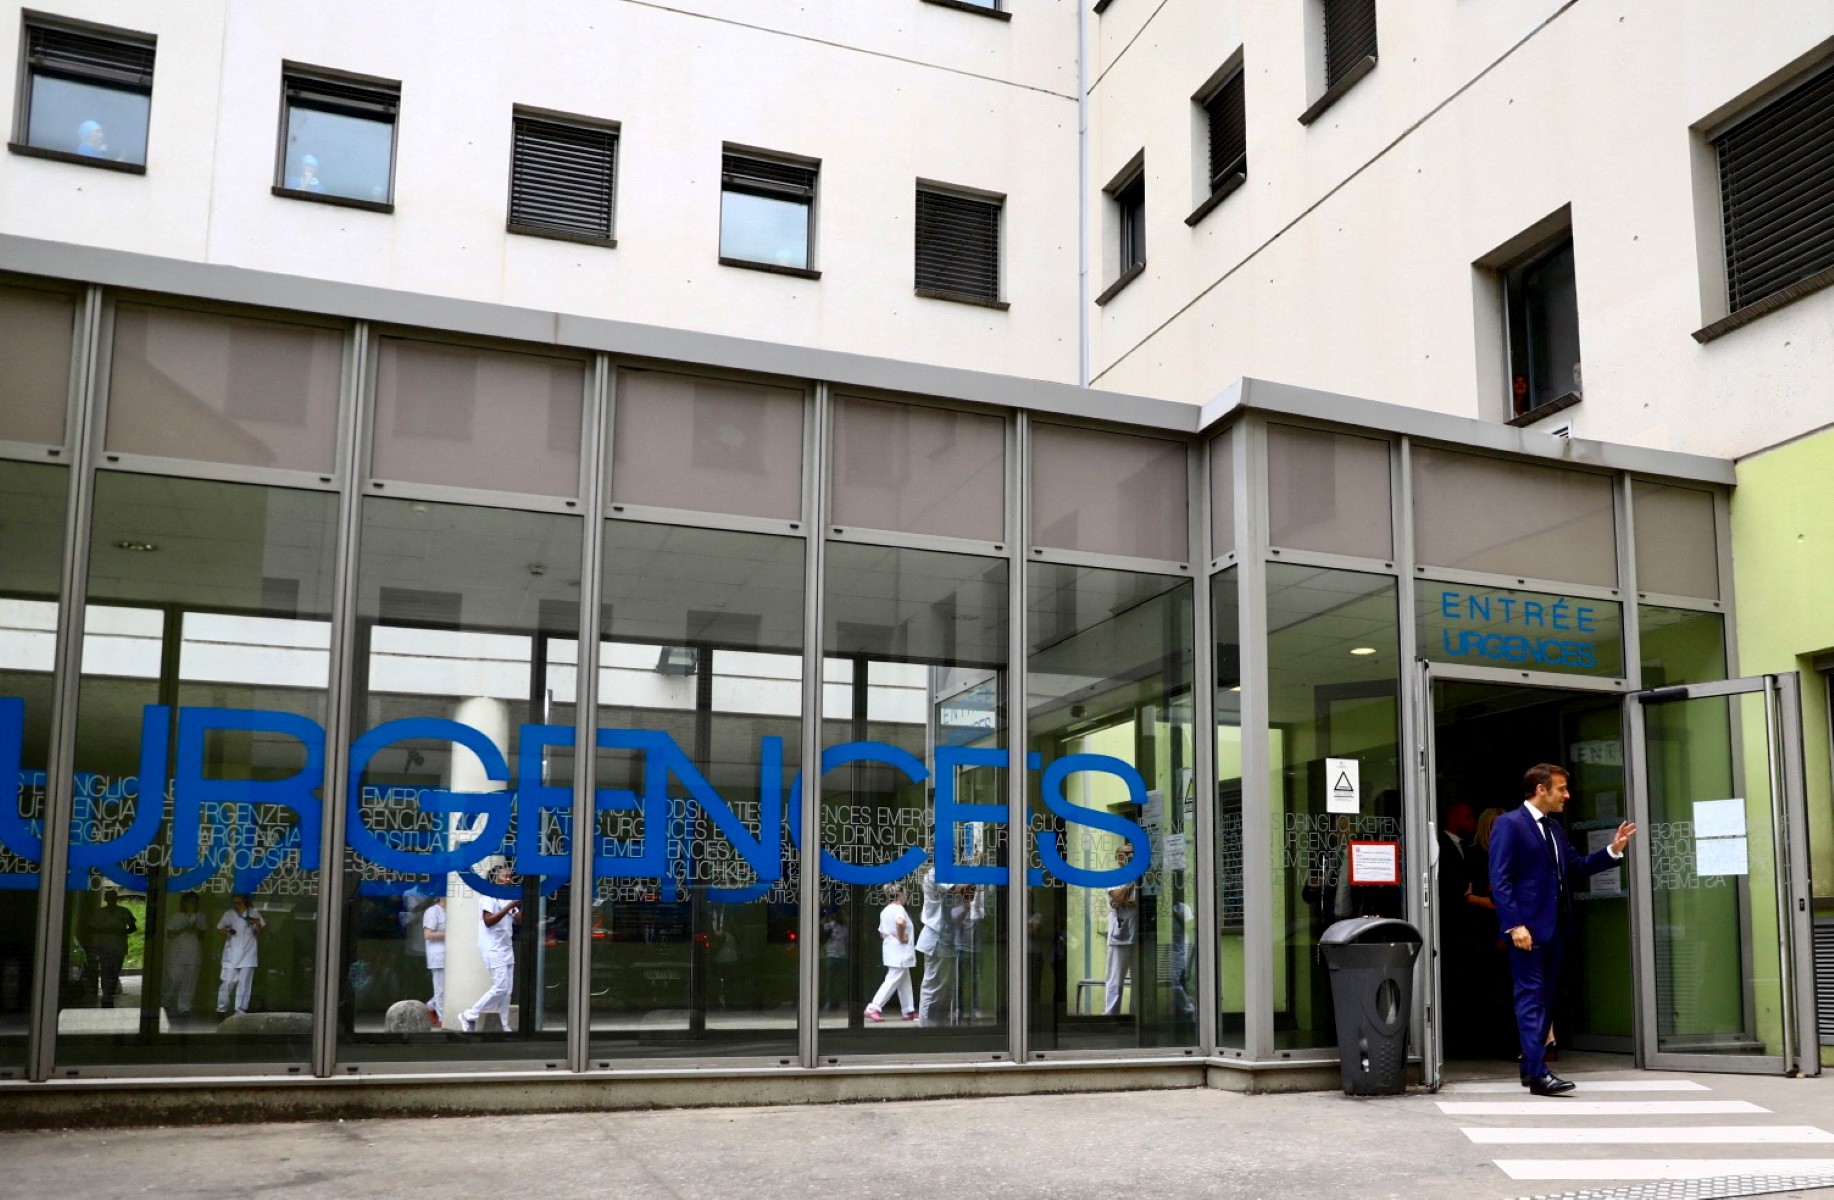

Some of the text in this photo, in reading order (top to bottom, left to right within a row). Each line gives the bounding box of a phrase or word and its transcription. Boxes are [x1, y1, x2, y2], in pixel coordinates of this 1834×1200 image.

[1441, 591, 1596, 633] ENTRÉE
[1442, 628, 1598, 669] URGENCES
[0, 697, 1149, 888] URGENCES
